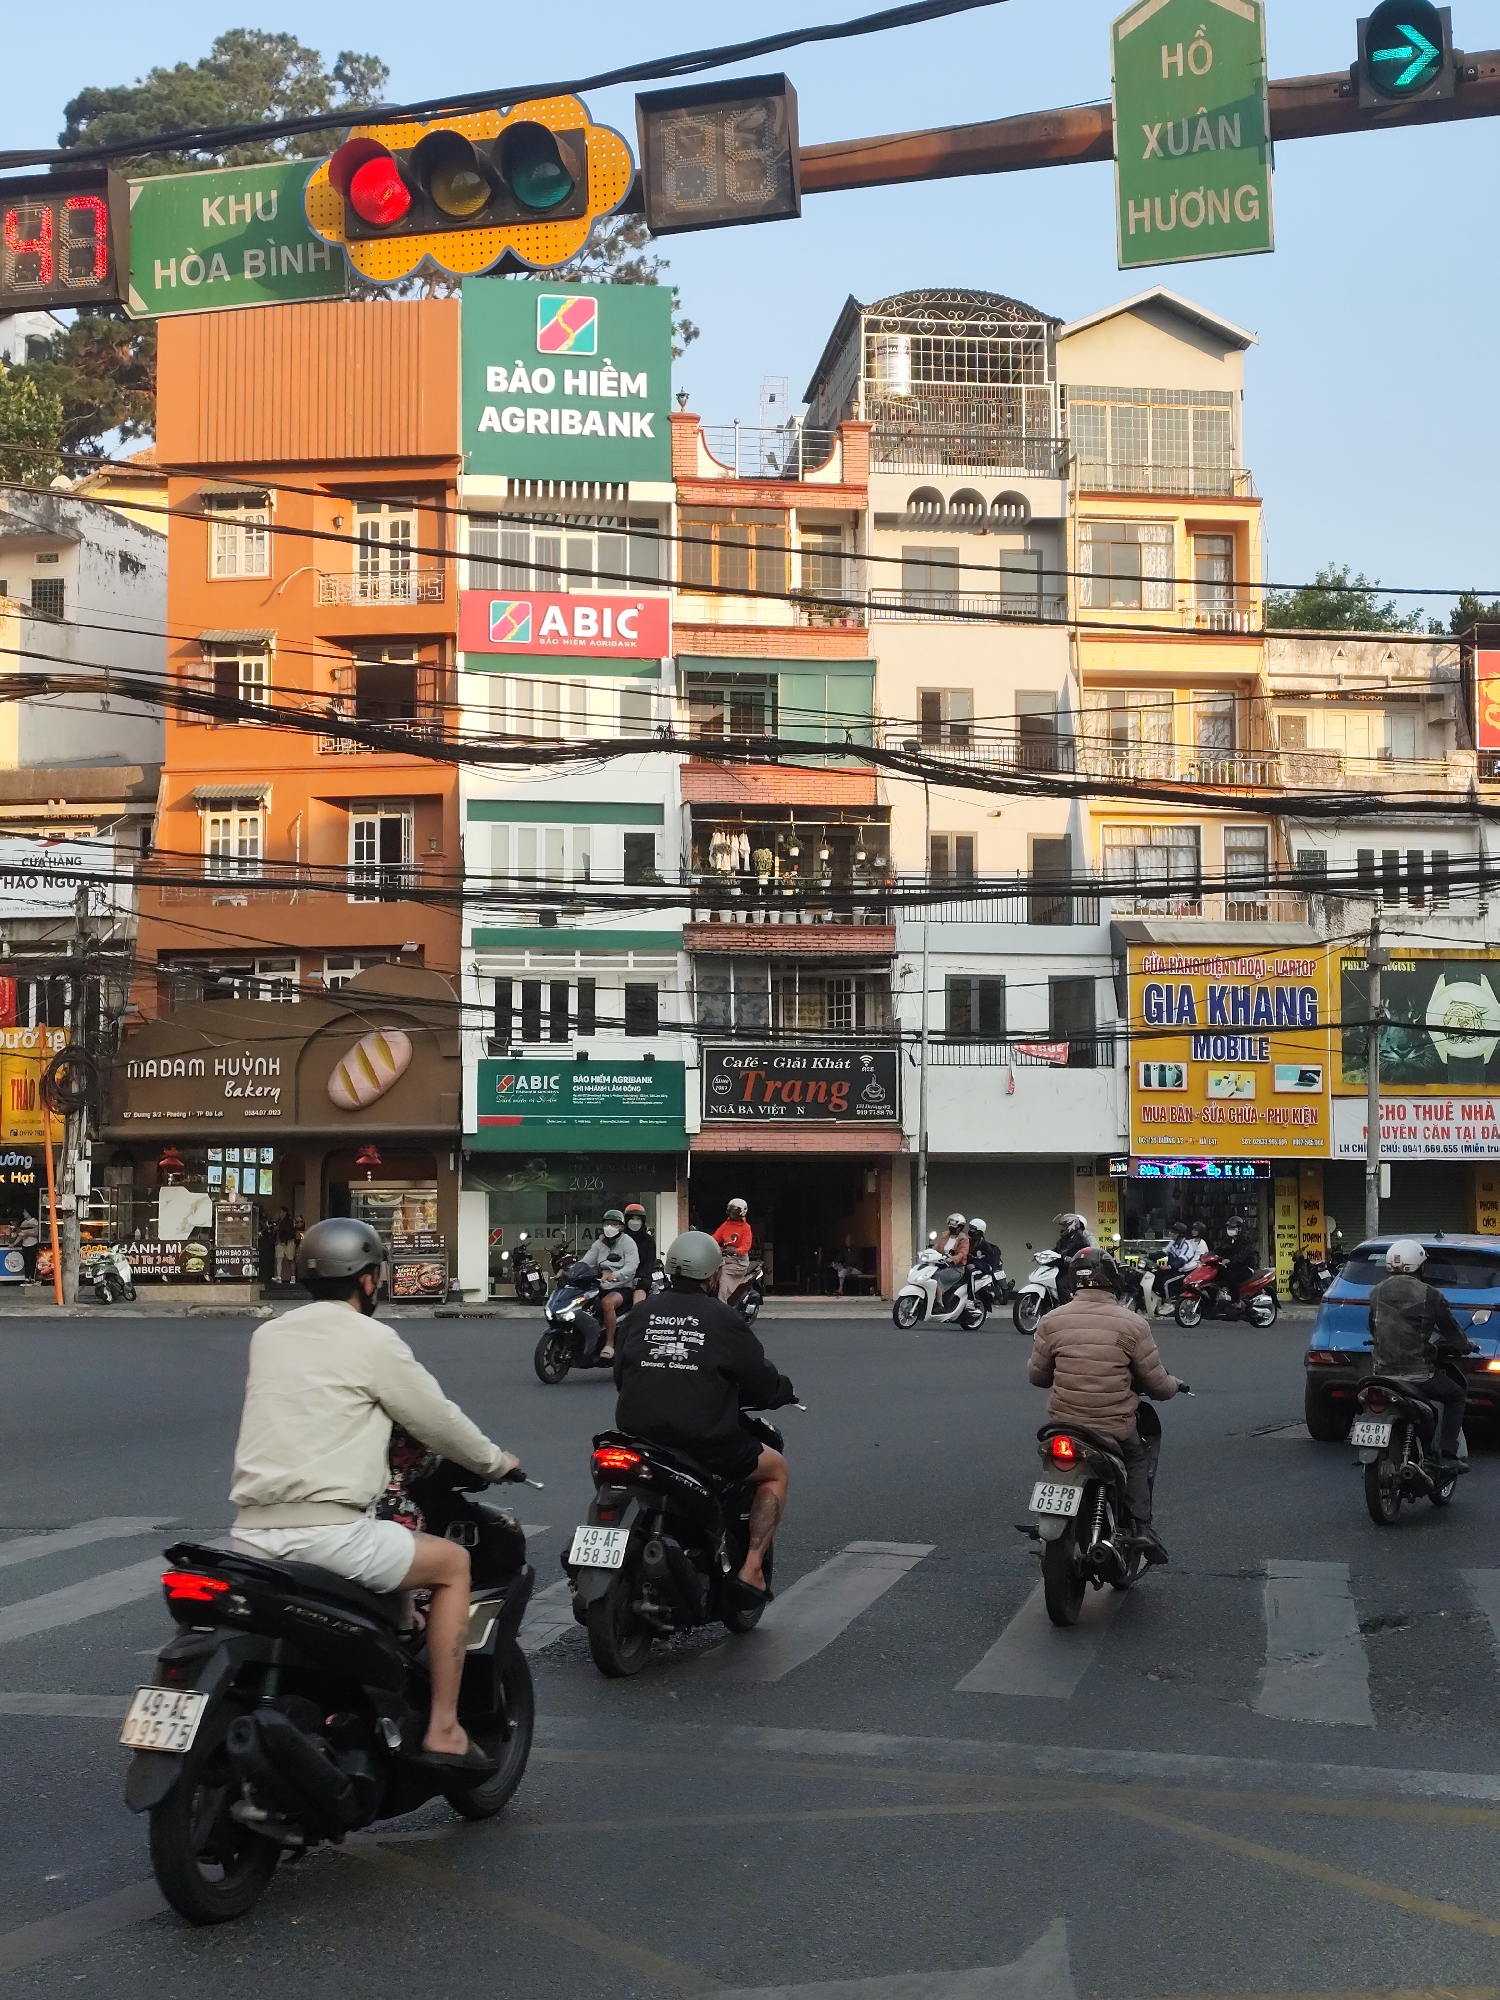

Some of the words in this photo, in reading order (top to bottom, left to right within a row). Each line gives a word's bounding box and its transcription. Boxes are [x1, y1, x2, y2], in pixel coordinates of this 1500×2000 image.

[1161, 24, 1213, 79] HỒ
[1142, 107, 1241, 159] XUÂN
[202, 189, 278, 227] KHU
[1128, 184, 1260, 235] HƯƠNG
[5, 195, 107, 284] 47
[154, 247, 231, 289] HÒA
[243, 239, 331, 280] BÌNH
[486, 360, 555, 394] BẢO
[564, 357, 648, 398] HIỂM
[477, 406, 655, 438] AGRIBANK
[538, 605, 638, 639] ABIC
[48, 854, 82, 866] HÀNG
[1143, 950, 1165, 975] CỬA
[1169, 953, 1200, 975] HÀNG
[1203, 953, 1233, 979] ĐIỆN
[1234, 958, 1266, 979] THOẠI
[1275, 959, 1317, 977] LAPTOP
[1143, 983, 1198, 1026] GIA
[1207, 984, 1319, 1027] KHANG
[1191, 1033, 1270, 1063] MOBILE
[127, 1058, 205, 1079] MADAM
[214, 1051, 280, 1077] HUỲNH
[723, 1056, 759, 1068] Café
[773, 1056, 807, 1069] Giải
[811, 1057, 851, 1069] Khát
[224, 1080, 281, 1104] Bakery
[516, 1075, 560, 1090] ABIC
[612, 1077, 653, 1085] AGRIBANK
[739, 1070, 851, 1113] Trang
[710, 1103, 735, 1114] NGÃ
[738, 1105, 754, 1115] BA
[758, 1103, 787, 1117] VIỆT
[1141, 1106, 1167, 1124] MUA
[1202, 1101, 1225, 1124] SỬA
[1229, 1104, 1258, 1124] CHỮA
[1267, 1107, 1289, 1128] PHỤ
[1292, 1105, 1319, 1128] KIỆN
[1378, 1104, 1407, 1121] CHO
[1413, 1101, 1454, 1121] THUÊ
[1461, 1101, 1496, 1121] NHÀ
[1423, 1123, 1451, 1140] CĂN
[1455, 1125, 1476, 1143] TẠI
[1339, 1144, 1350, 1153] LH
[11, 1171, 36, 1186] Hạt
[570, 1176, 604, 1190] 2026
[668, 1361, 699, 1371] Colorado
[1355, 1434, 1387, 1445] 146.84
[1360, 1424, 1385, 1434] 49-B1
[1040, 1485, 1076, 1500] 49-P8
[1036, 1499, 1072, 1512] 0538
[582, 1530, 620, 1547] 49-AF
[575, 1547, 620, 1565] 158.30
